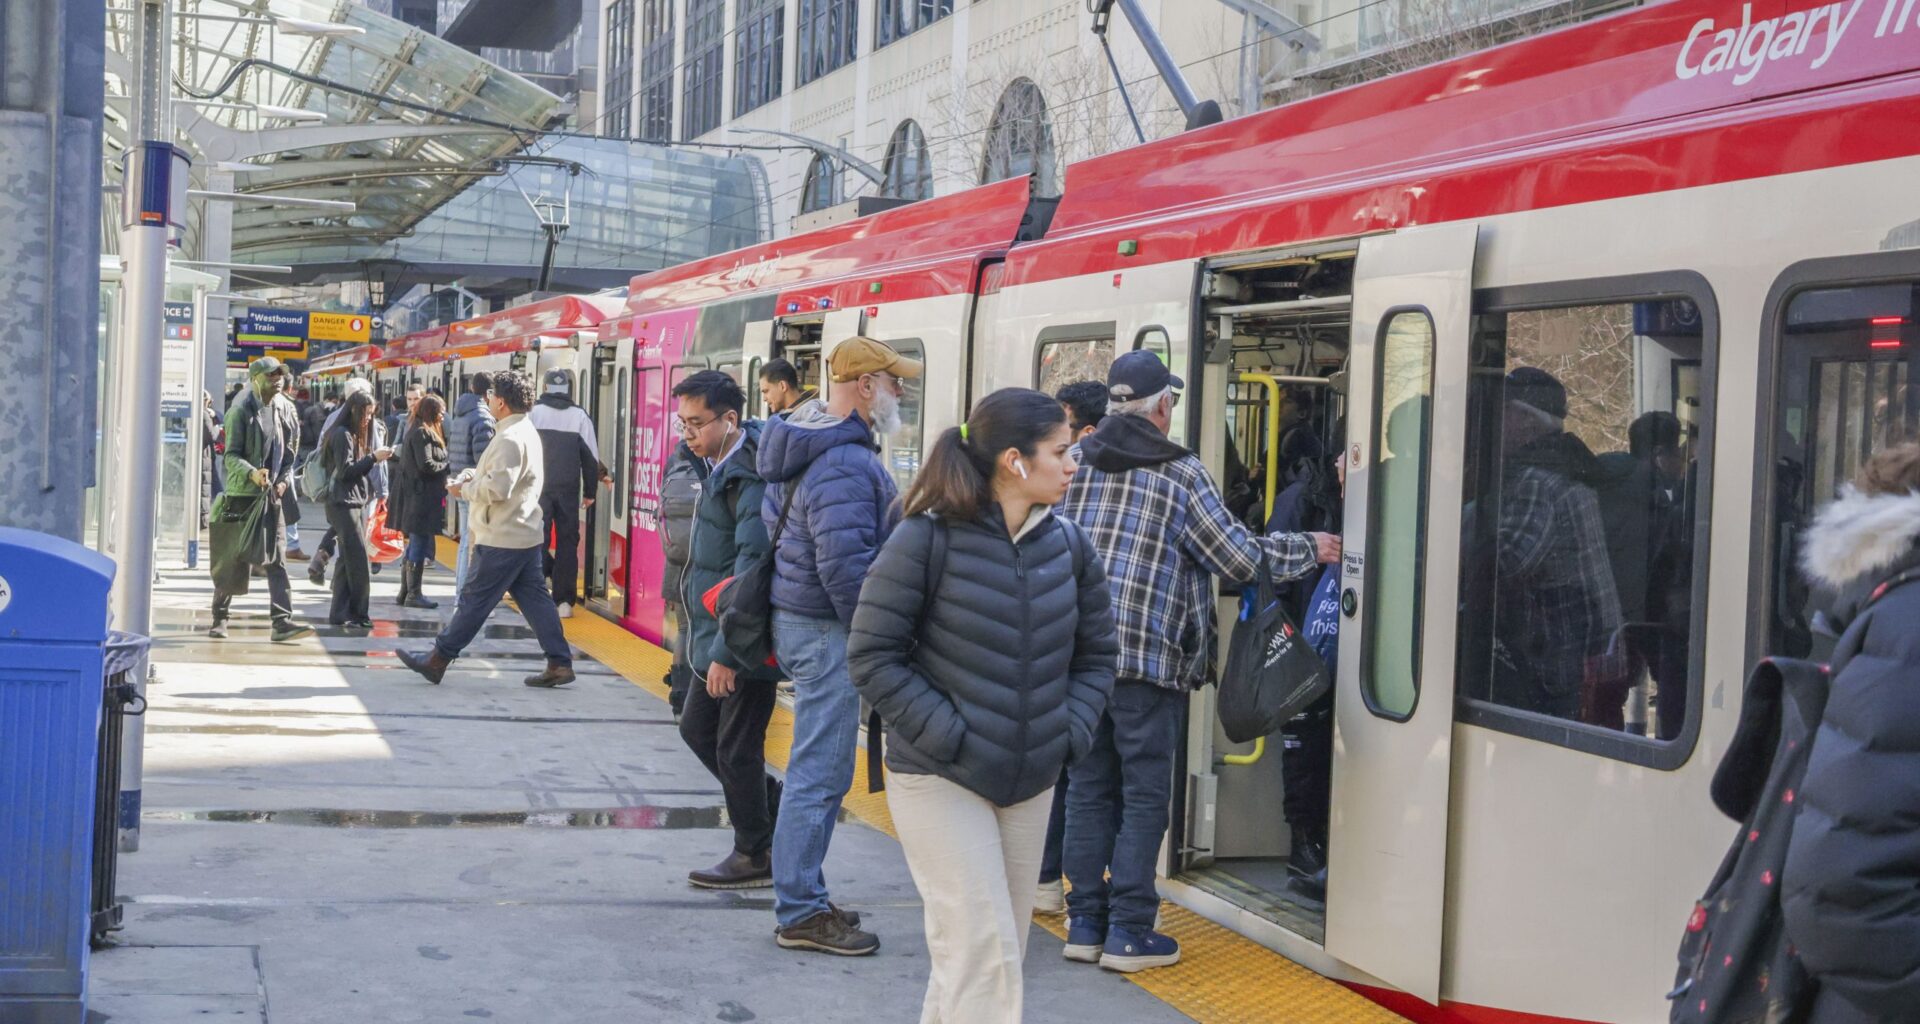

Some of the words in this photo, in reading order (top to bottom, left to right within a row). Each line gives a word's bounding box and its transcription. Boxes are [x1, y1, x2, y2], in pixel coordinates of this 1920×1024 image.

[1675, 0, 1864, 86] Calgary
[254, 313, 303, 325] Westbound
[313, 316, 346, 325] DANGER
[254, 323, 275, 332] Train
[643, 427, 654, 458] UP
[632, 461, 650, 494] LOSE
[1343, 553, 1357, 564] Press
[1358, 556, 1363, 565] to
[1346, 563, 1360, 575] Open
[1311, 618, 1338, 636] This
